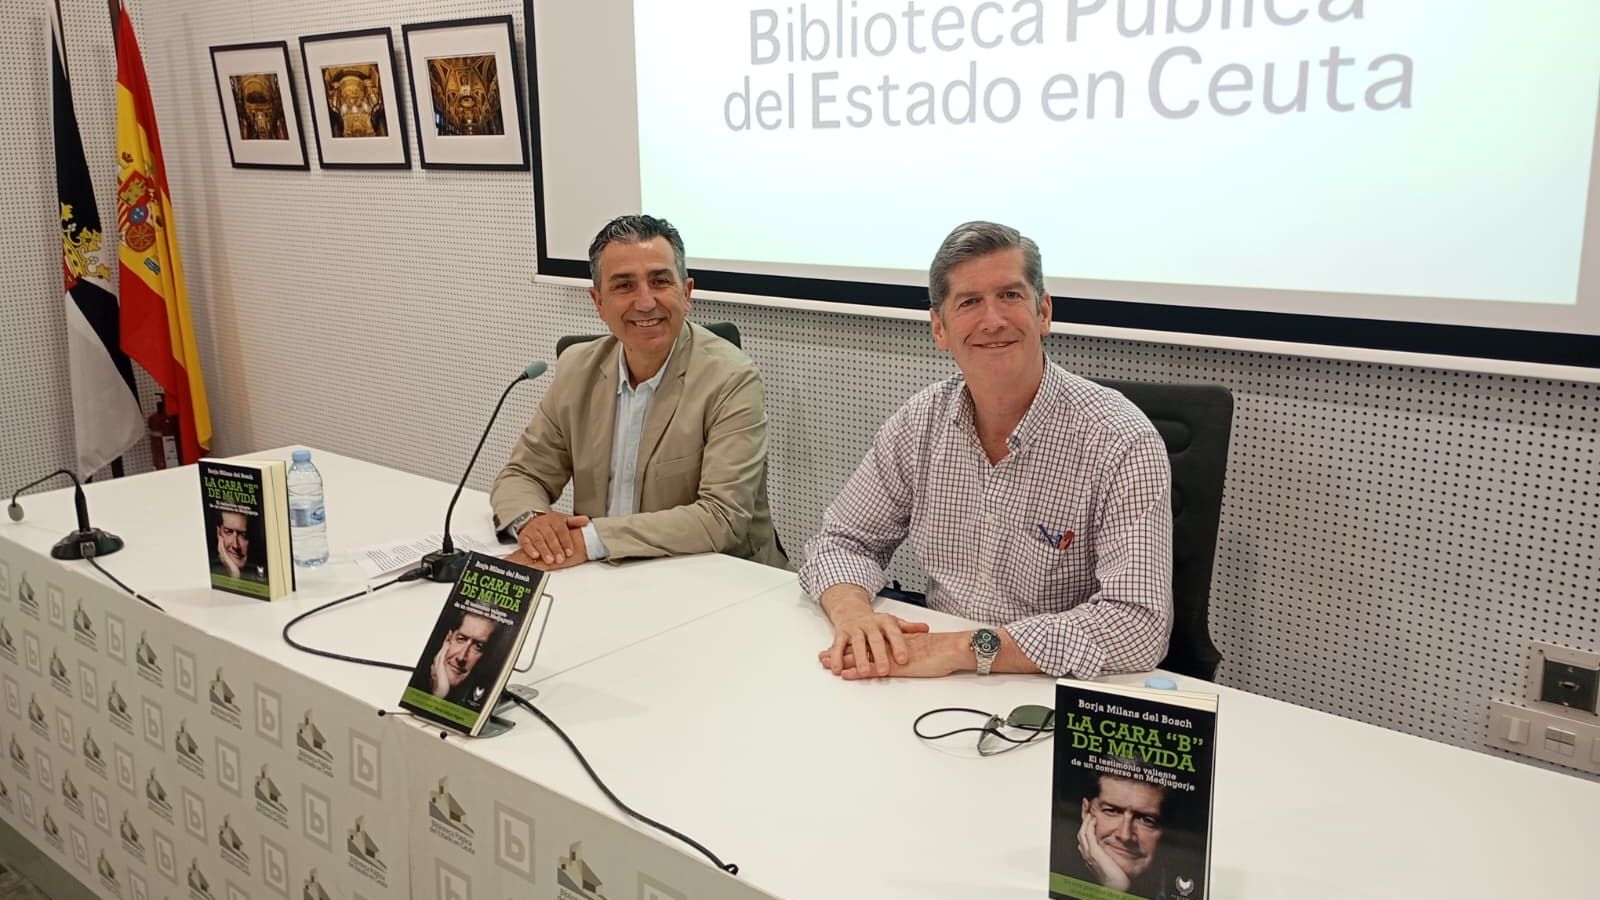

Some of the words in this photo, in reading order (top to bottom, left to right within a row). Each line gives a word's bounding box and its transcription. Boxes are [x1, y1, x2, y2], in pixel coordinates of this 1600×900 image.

[750, 0, 1044, 65] Biblioteca
[724, 73, 795, 132] del
[811, 60, 1021, 129] Estado
[1041, 70, 1125, 122] en
[1148, 45, 1413, 120] Ceuta
[204, 476, 217, 488] LA
[217, 479, 243, 492] CARA
[208, 488, 221, 499] DE
[222, 490, 234, 501] MI
[234, 492, 258, 505] VIDA
[460, 583, 479, 599] DE
[477, 588, 495, 603] MI
[494, 593, 521, 612] VIDA
[463, 570, 480, 585] LA
[480, 575, 511, 595] CARA
[1078, 699, 1104, 713] Borja
[1106, 705, 1140, 718] Milans
[1142, 712, 1159, 723] del
[1161, 715, 1193, 729] Bosch
[1066, 712, 1095, 734] LA
[1099, 720, 1162, 747] CARA
[1072, 731, 1102, 753] DE
[1107, 738, 1135, 760] MI
[1138, 745, 1196, 773] VIDA
[1070, 758, 1082, 767] de
[1083, 761, 1097, 769] un
[1095, 764, 1132, 778] converso
[1133, 772, 1144, 781] en
[1145, 774, 1196, 792] Medjugorje
[1088, 755, 1097, 763] El
[1098, 757, 1142, 773] testimonio
[1143, 767, 1177, 781] valiente
